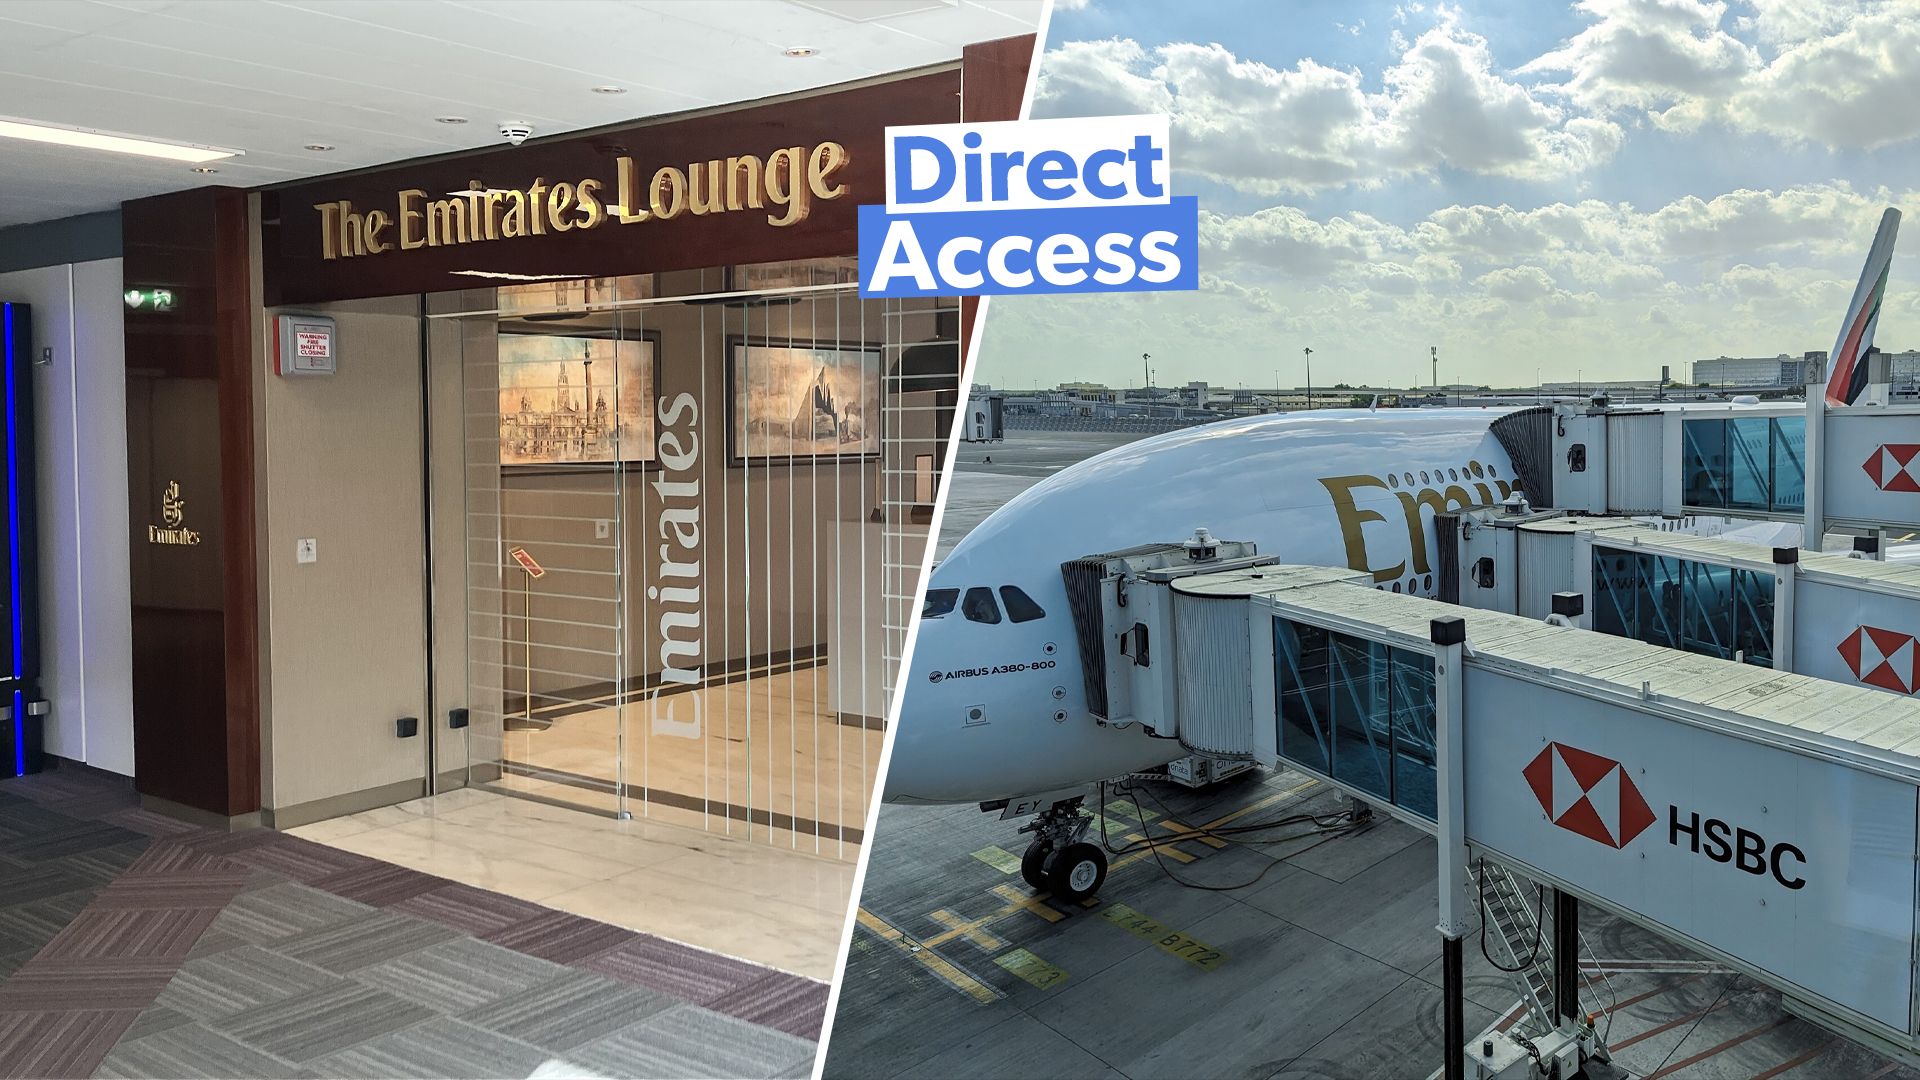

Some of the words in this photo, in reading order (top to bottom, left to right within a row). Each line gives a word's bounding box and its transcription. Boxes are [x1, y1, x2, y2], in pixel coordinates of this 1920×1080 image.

[313, 199, 394, 260] The
[399, 177, 606, 250] Emirates
[616, 141, 850, 227] Lounge
[149, 524, 200, 545] Emirates
[648, 392, 700, 740] Emirates
[945, 667, 989, 680] AIRBUS
[991, 660, 1056, 675] A380-800
[1015, 800, 1042, 815] EY
[1669, 804, 1807, 890] HSBC
[1160, 934, 1220, 965] B772
